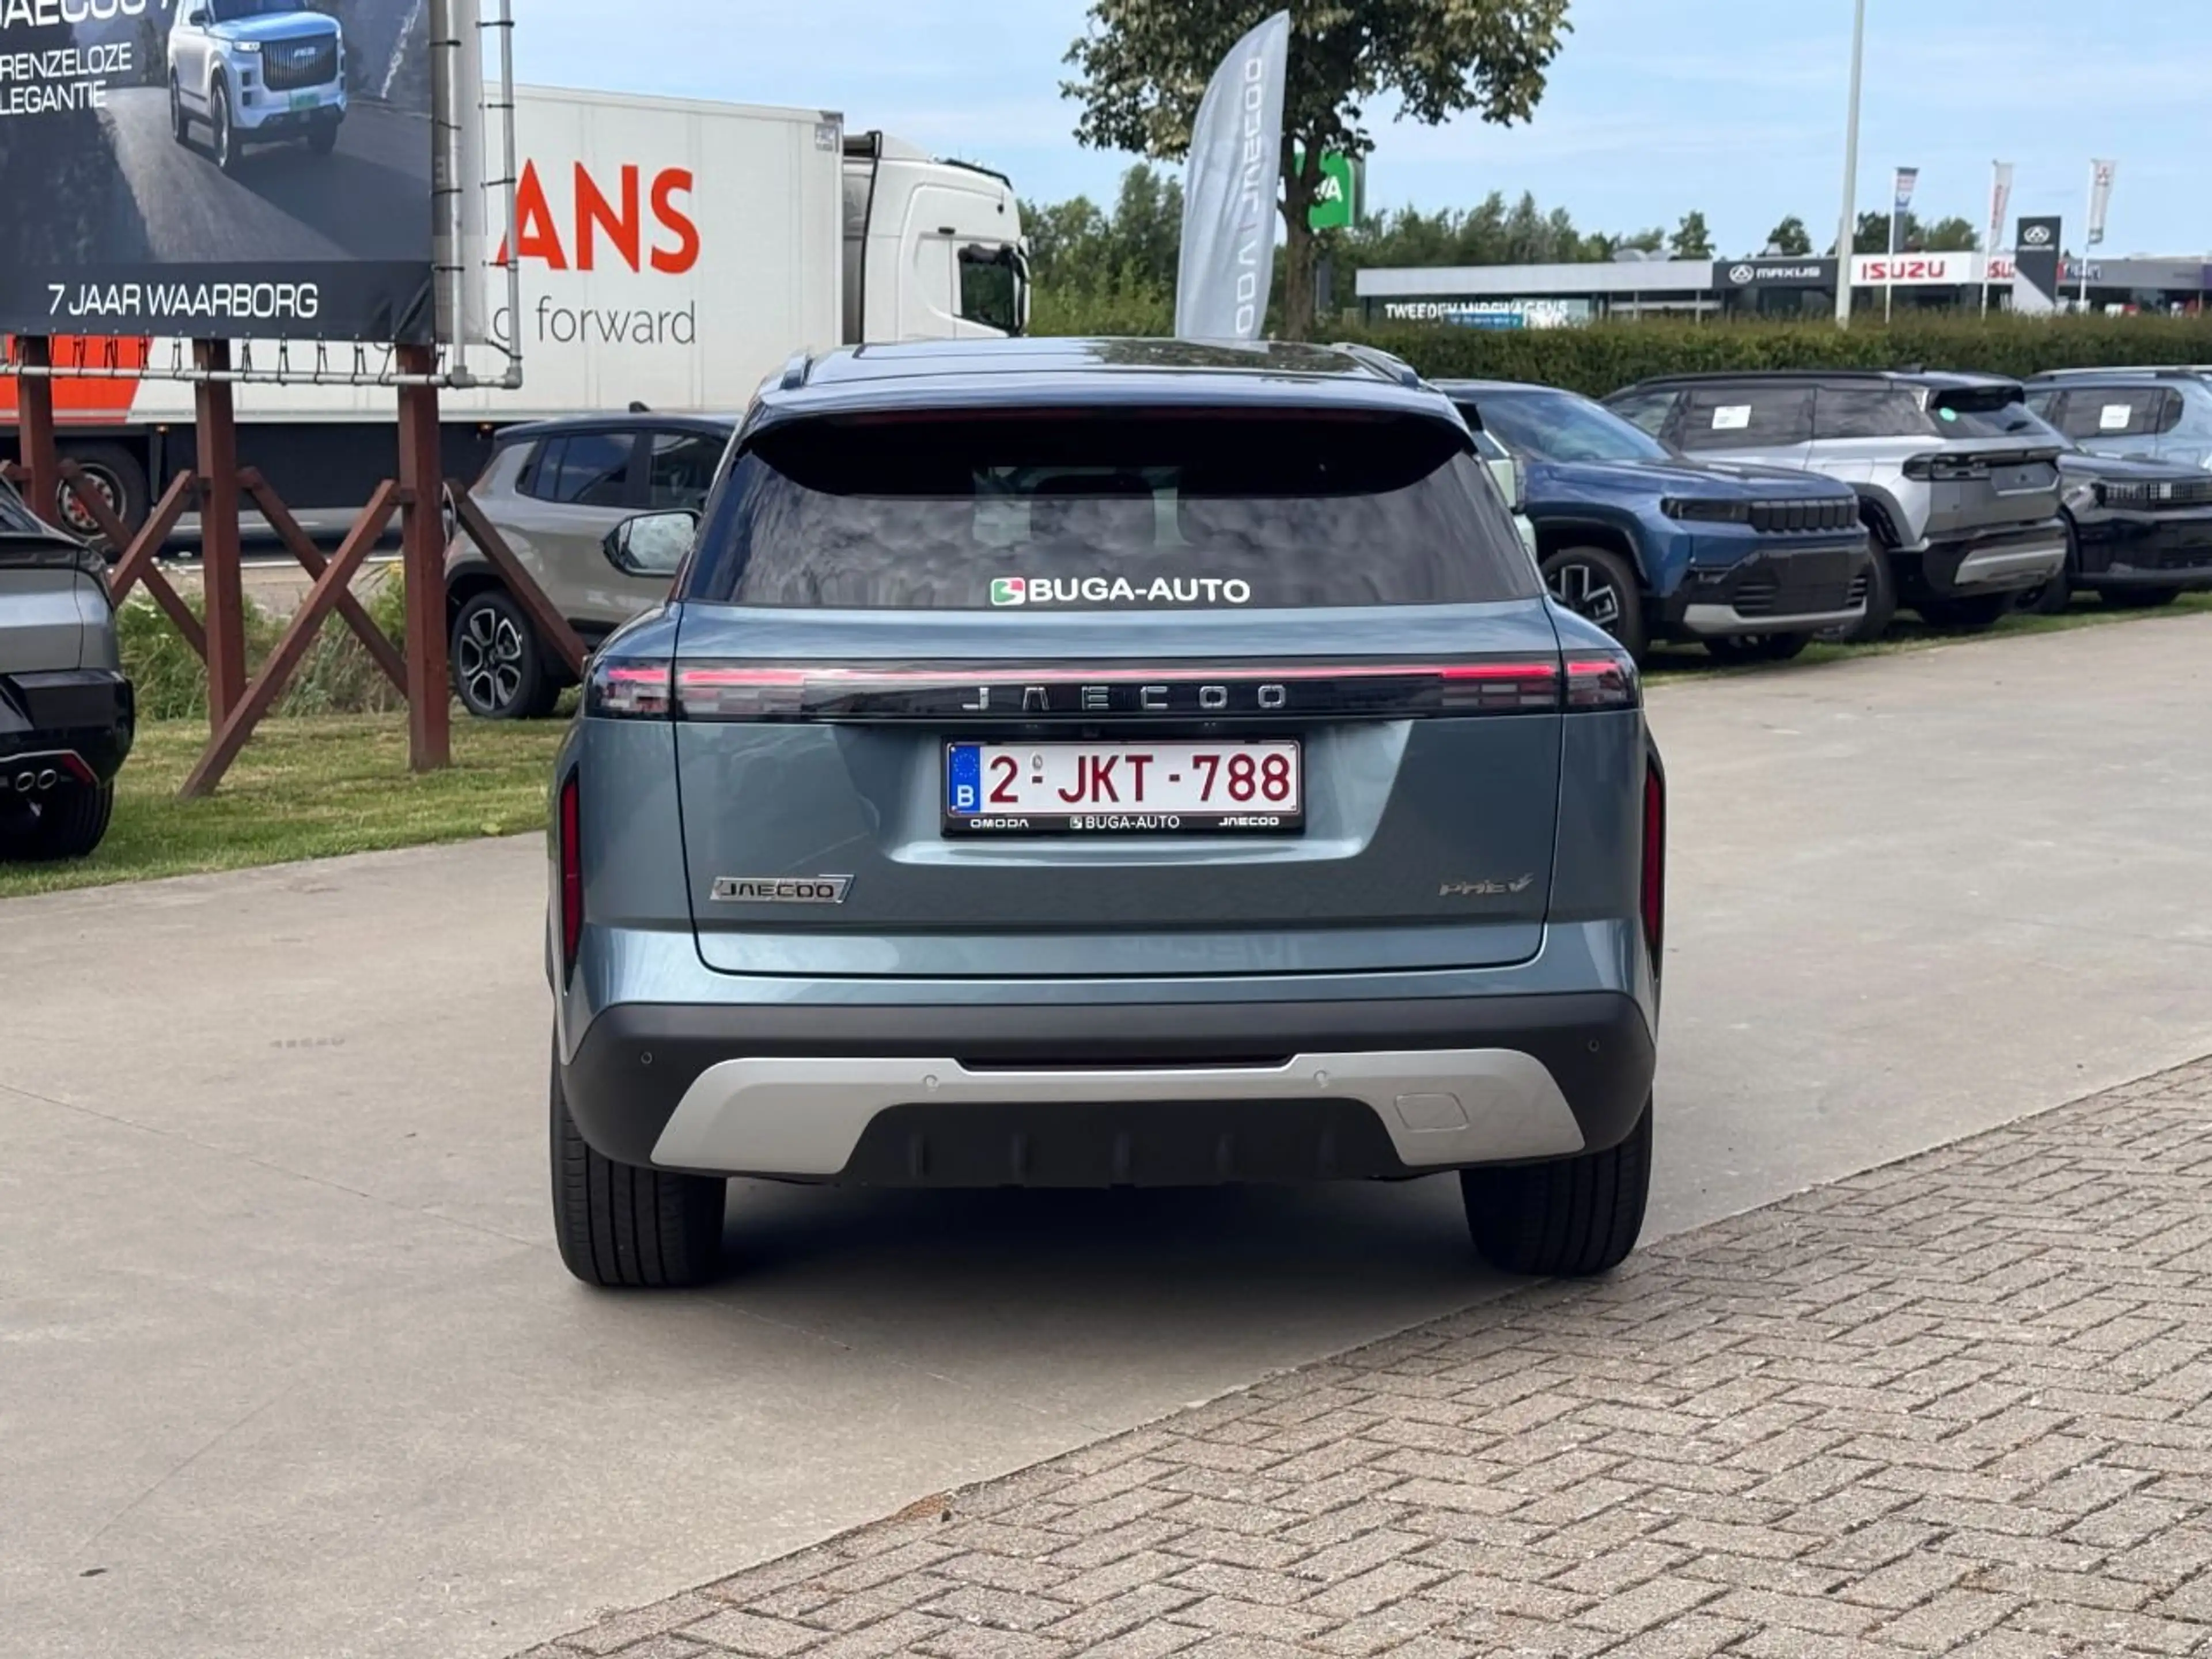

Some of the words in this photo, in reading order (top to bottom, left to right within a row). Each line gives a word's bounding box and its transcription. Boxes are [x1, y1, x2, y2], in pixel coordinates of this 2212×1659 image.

[1757, 266, 1821, 279] MAXUS
[1862, 261, 1945, 279] ISUZU
[48, 284, 65, 315] 7
[69, 284, 140, 316] JAAR
[146, 283, 319, 318] WAARBORG
[536, 295, 695, 344] forward
[1028, 577, 1251, 604] BUGA-AUTO
[962, 685, 1286, 711] JAECOO
[957, 785, 974, 806] B
[970, 819, 1029, 828] OMODA
[1085, 815, 1180, 830] BUGA-AUTO
[1218, 817, 1279, 826] JAECOO
[721, 882, 835, 898] JAECOO
